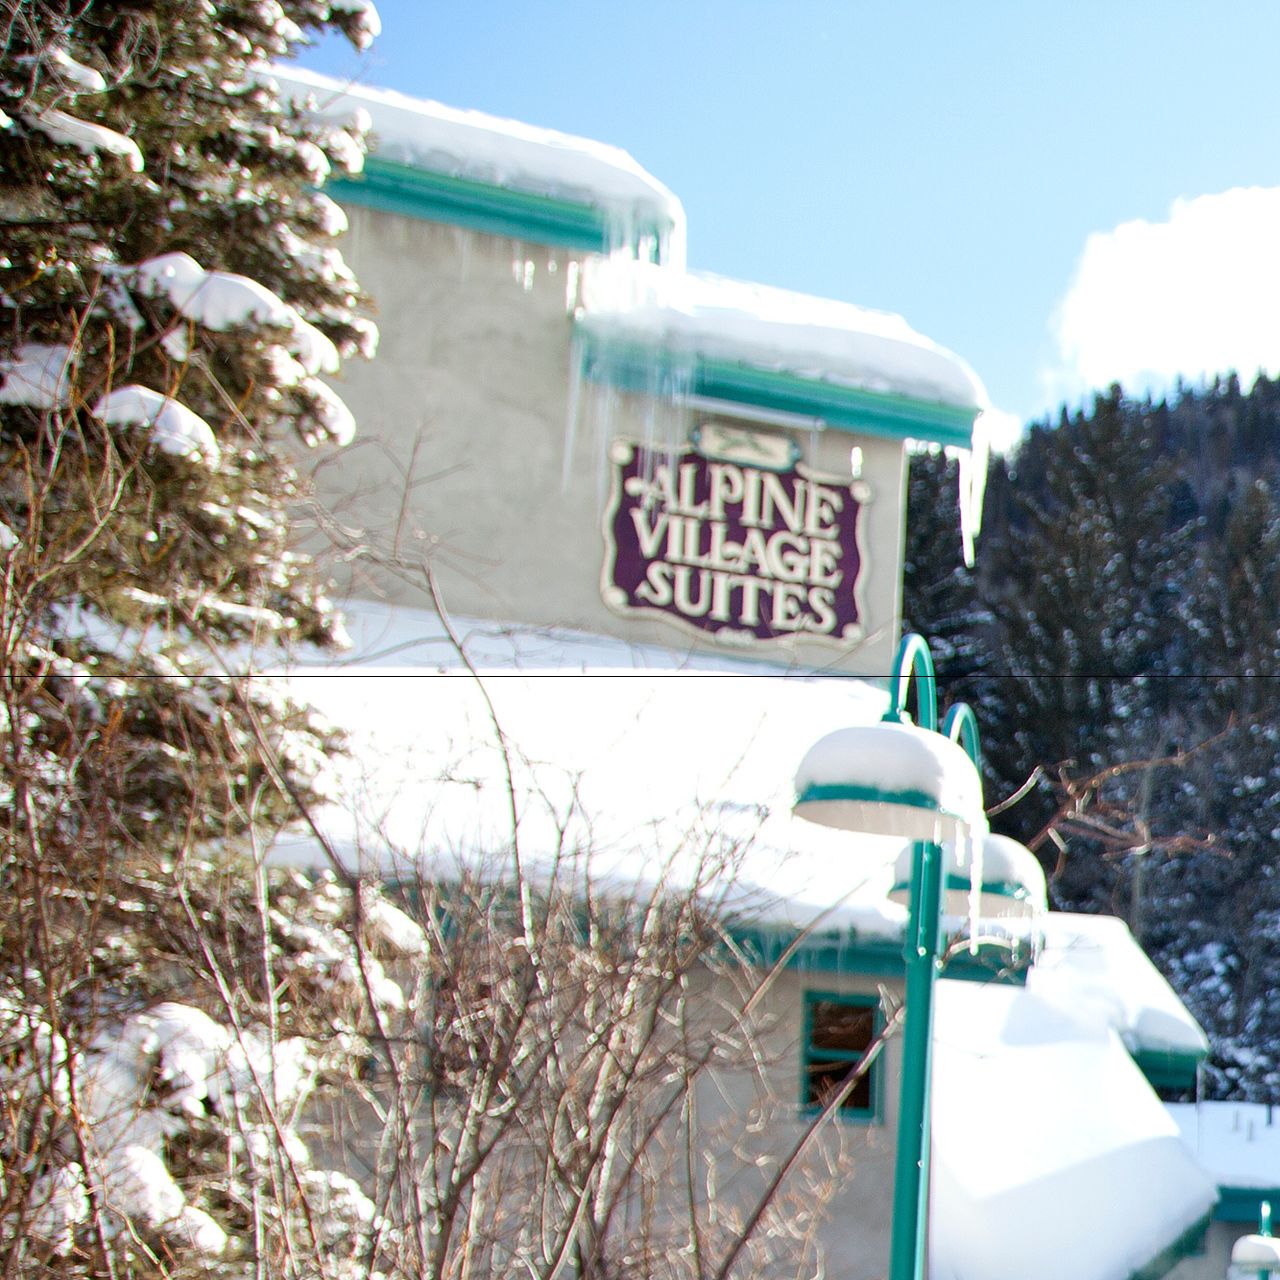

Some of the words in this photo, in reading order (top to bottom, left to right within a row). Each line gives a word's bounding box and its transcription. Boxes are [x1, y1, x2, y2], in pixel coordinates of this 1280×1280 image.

[625, 462, 844, 540] ALPINE
[629, 506, 844, 589] VILLAGE
[635, 560, 838, 634] SUITES
